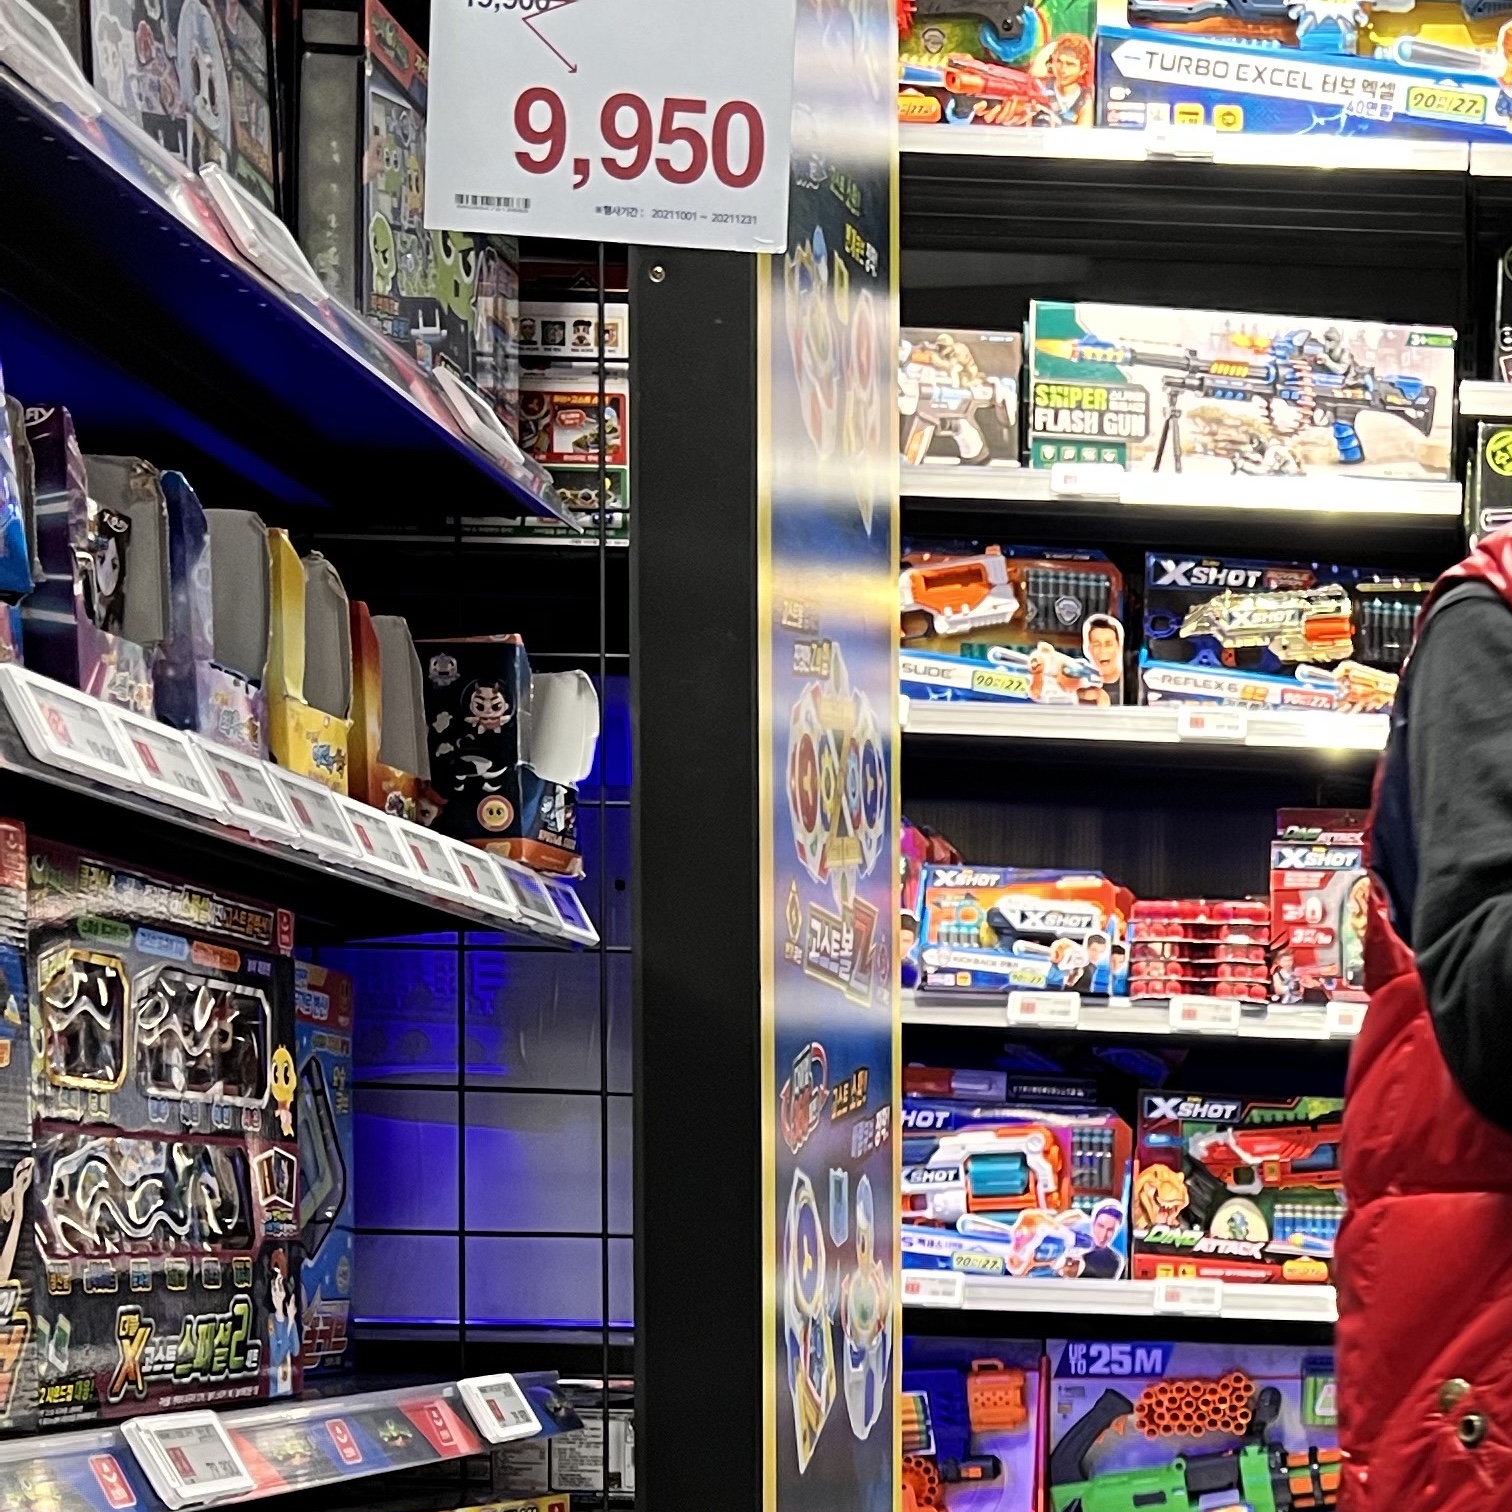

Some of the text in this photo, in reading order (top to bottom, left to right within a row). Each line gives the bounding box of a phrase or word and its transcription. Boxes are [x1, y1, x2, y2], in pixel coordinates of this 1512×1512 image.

[1146, 51, 1229, 79] TURBO
[1236, 64, 1313, 91] EXCEL
[514, 87, 765, 190] 9,950
[651, 209, 698, 221] 20211001
[711, 213, 758, 225] 20211231
[1034, 408, 1146, 437] FLASH GUN
[1161, 674, 1225, 691] REFLEX
[1194, 1238, 1266, 1260] ATTACK
[1068, 1344, 1087, 1360] UP
[1069, 1359, 1087, 1375] TO
